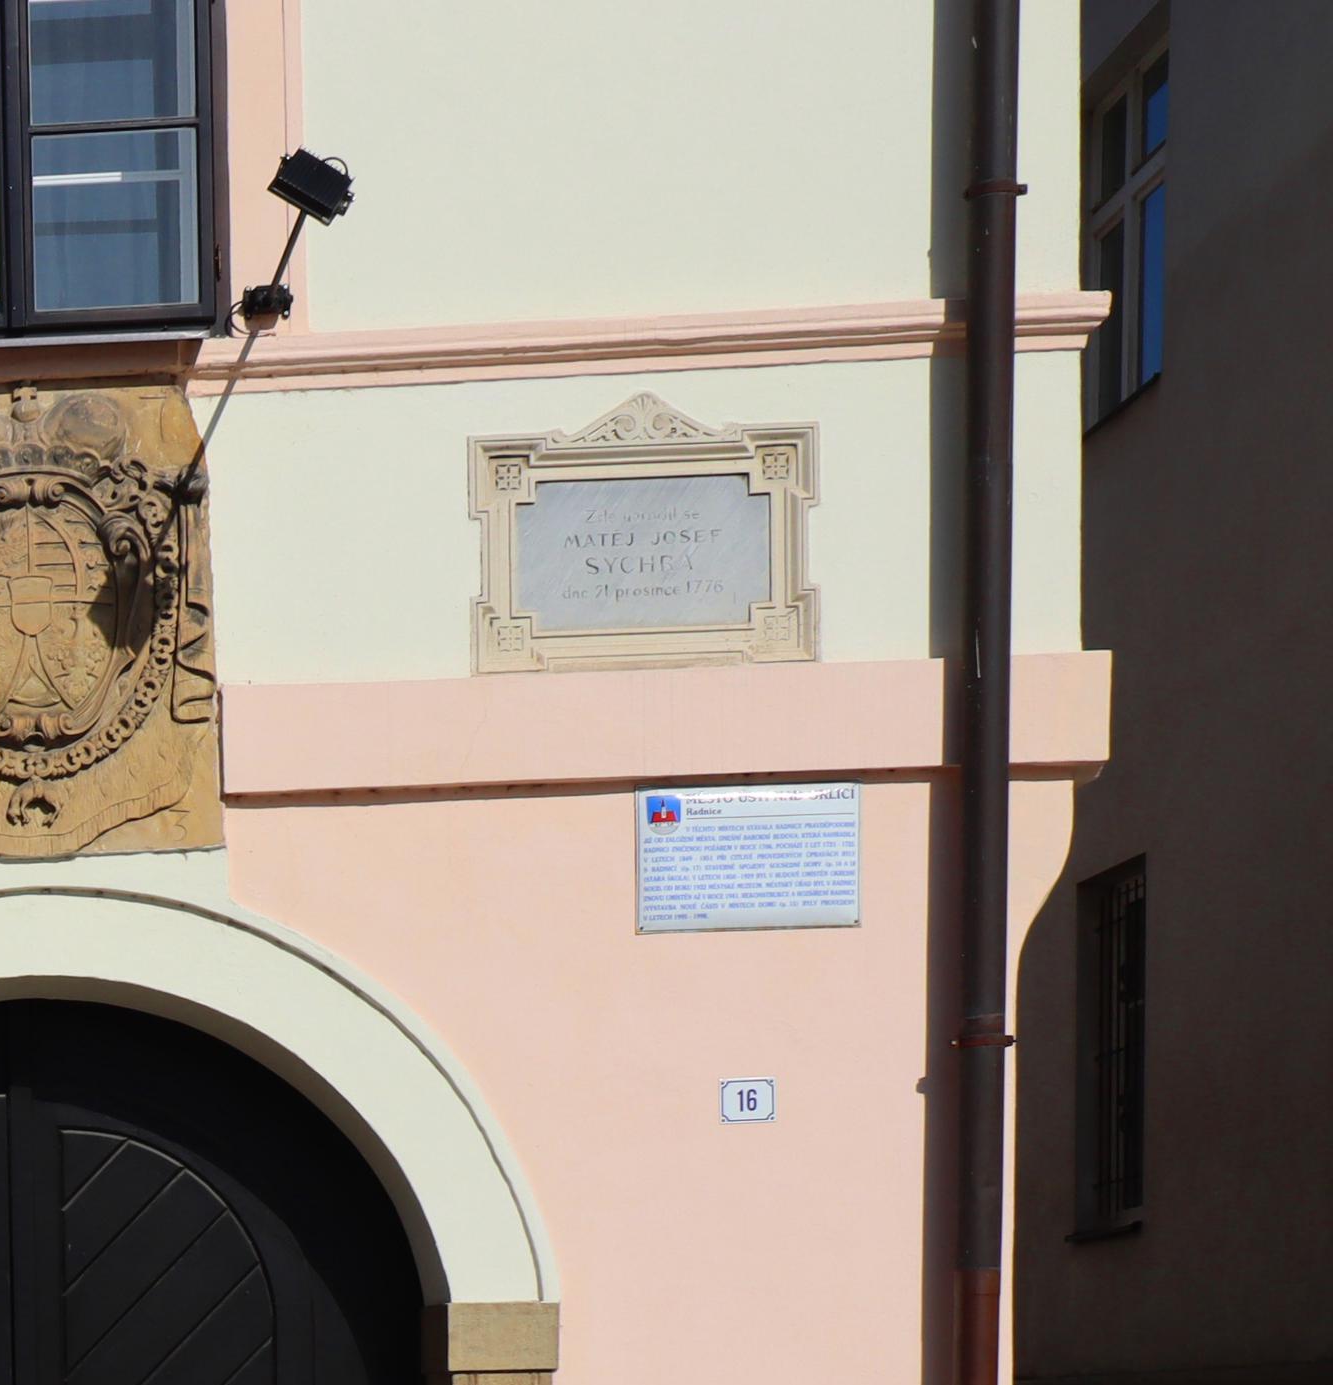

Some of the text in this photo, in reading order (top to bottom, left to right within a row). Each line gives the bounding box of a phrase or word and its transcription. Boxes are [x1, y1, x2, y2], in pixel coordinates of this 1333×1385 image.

[651, 528, 722, 546] JOSEF
[685, 578, 724, 595] 1776
[686, 807, 722, 816] Radnice
[737, 1088, 757, 1112] 16
